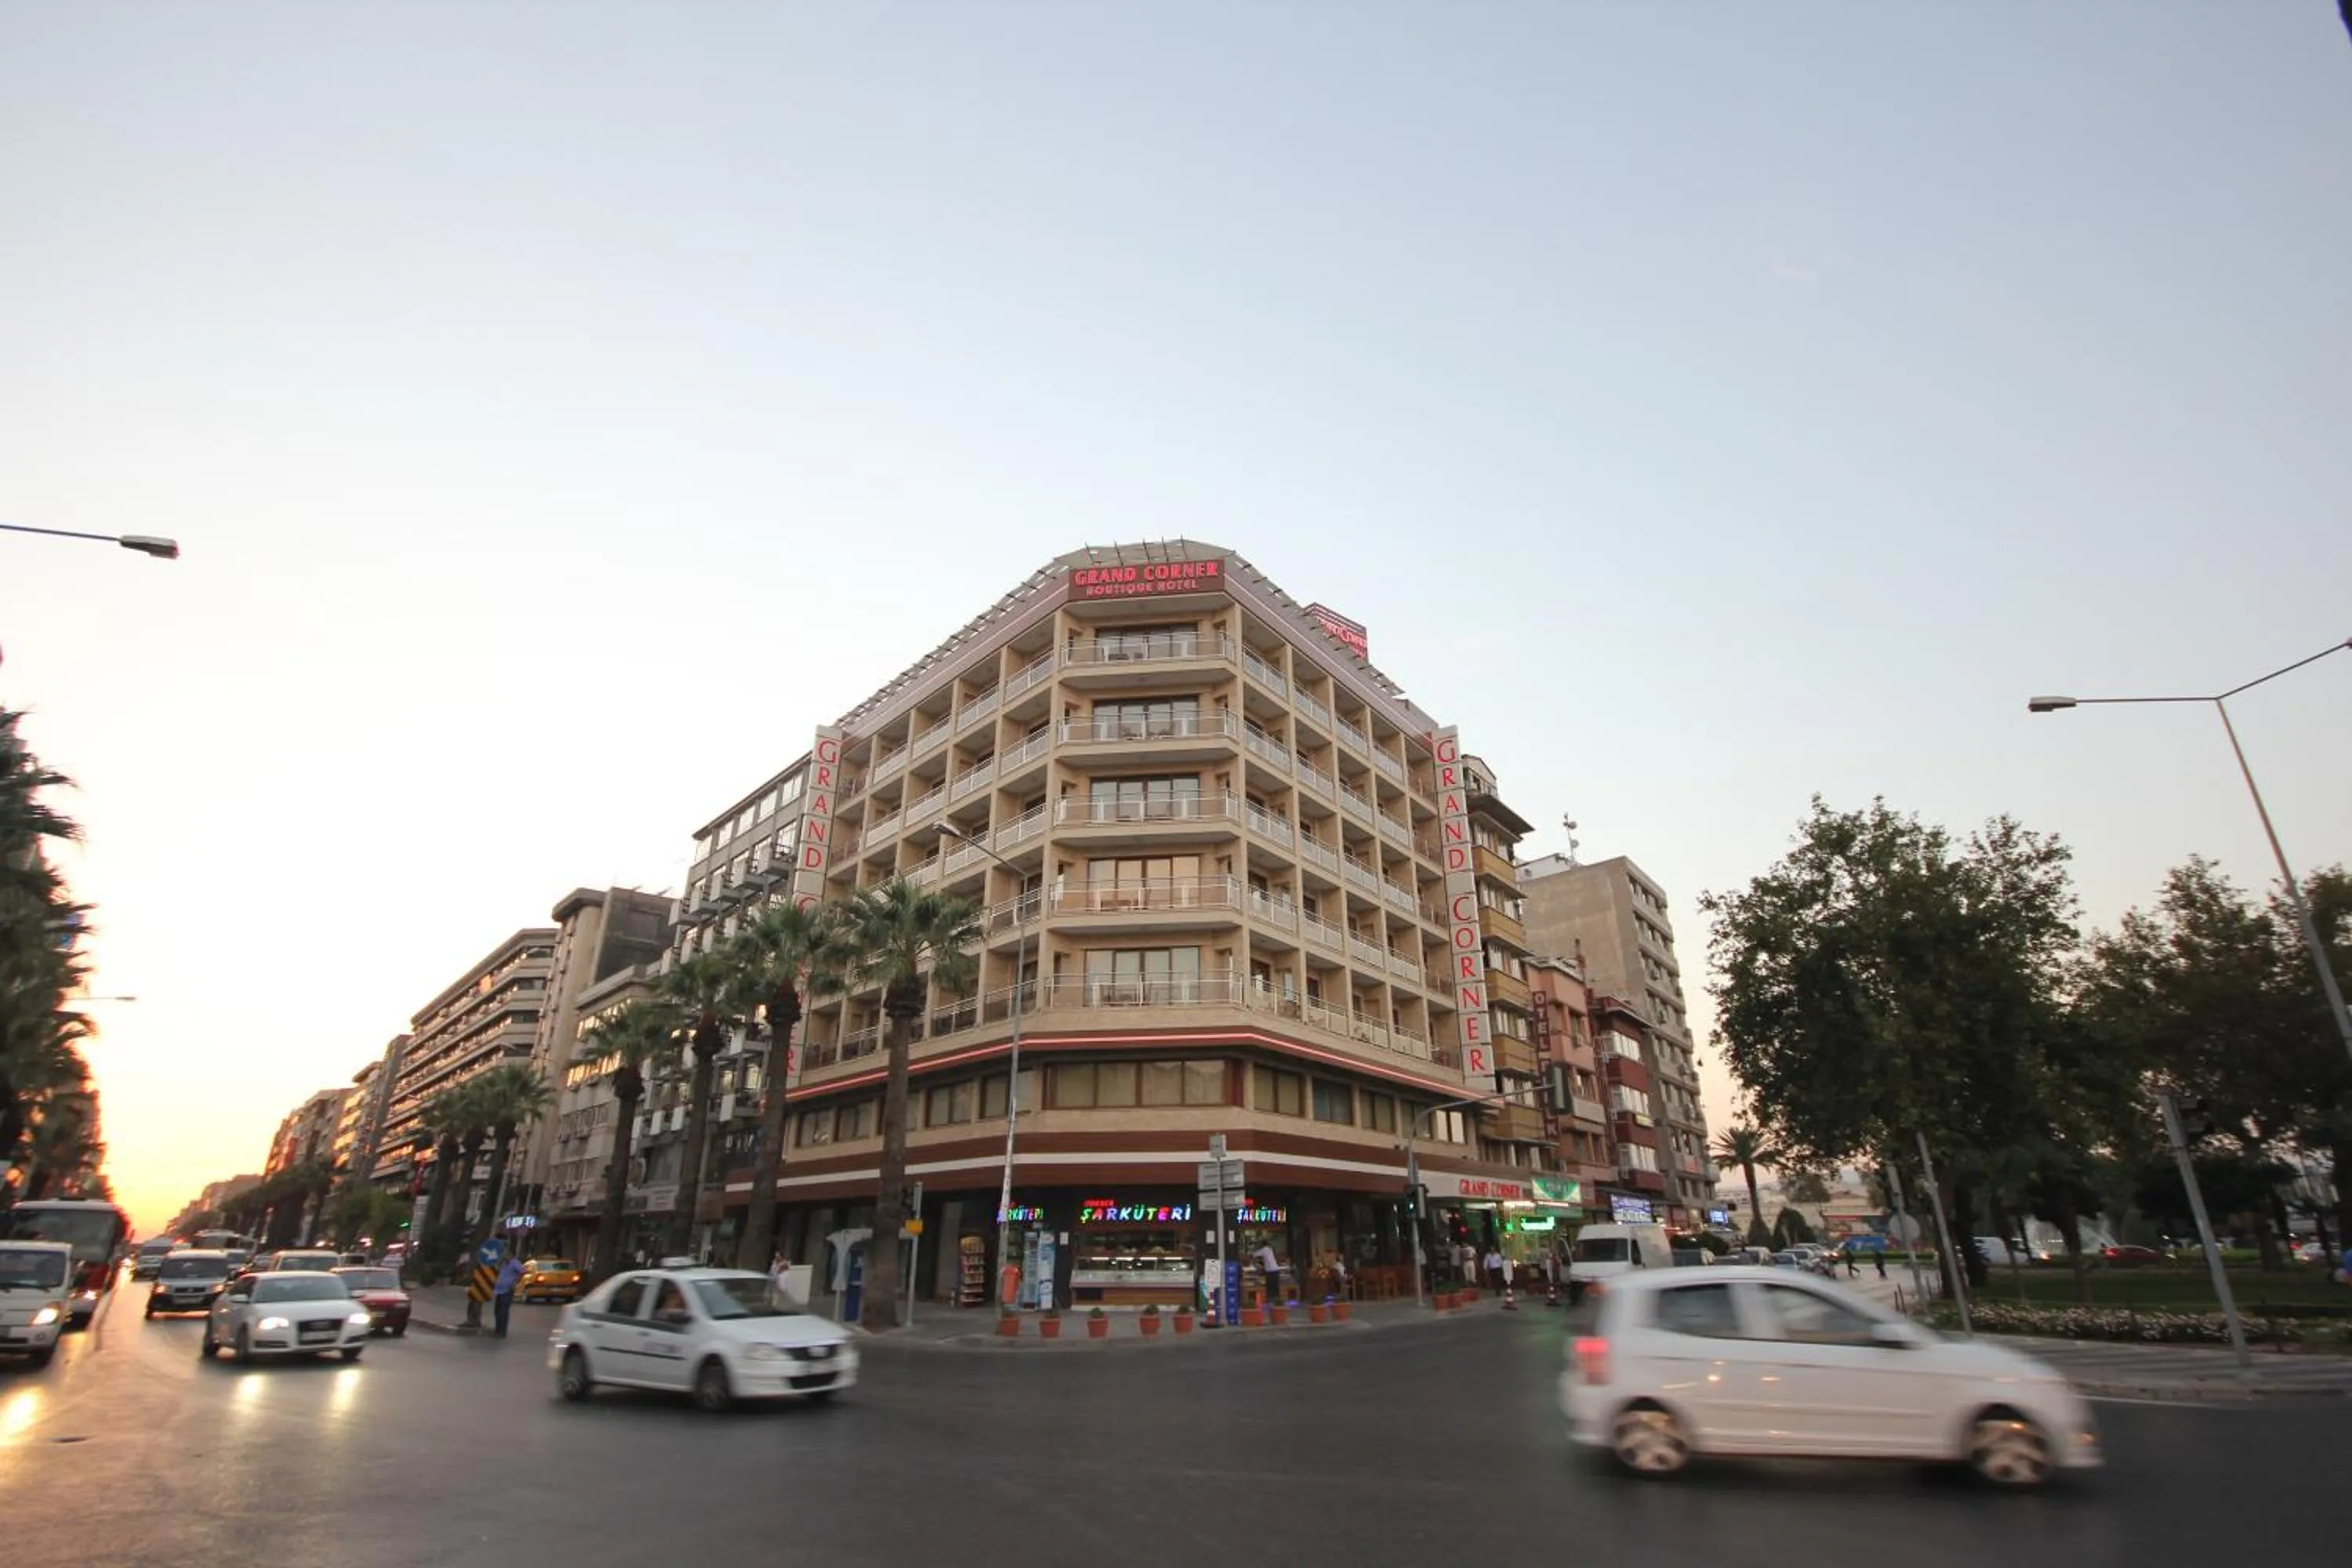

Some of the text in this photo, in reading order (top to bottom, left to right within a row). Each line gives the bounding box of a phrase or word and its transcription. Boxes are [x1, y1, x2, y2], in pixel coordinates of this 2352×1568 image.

[1076, 561, 1218, 585] GRAND CORNER
[1156, 579, 1199, 592] HOTEL
[804, 740, 837, 868] GRAND
[1437, 740, 1485, 1073] GRAND CORNER
[1534, 993, 1549, 1049] OTEL
[1080, 1204, 1191, 1223] ŞARKÜTERİ
